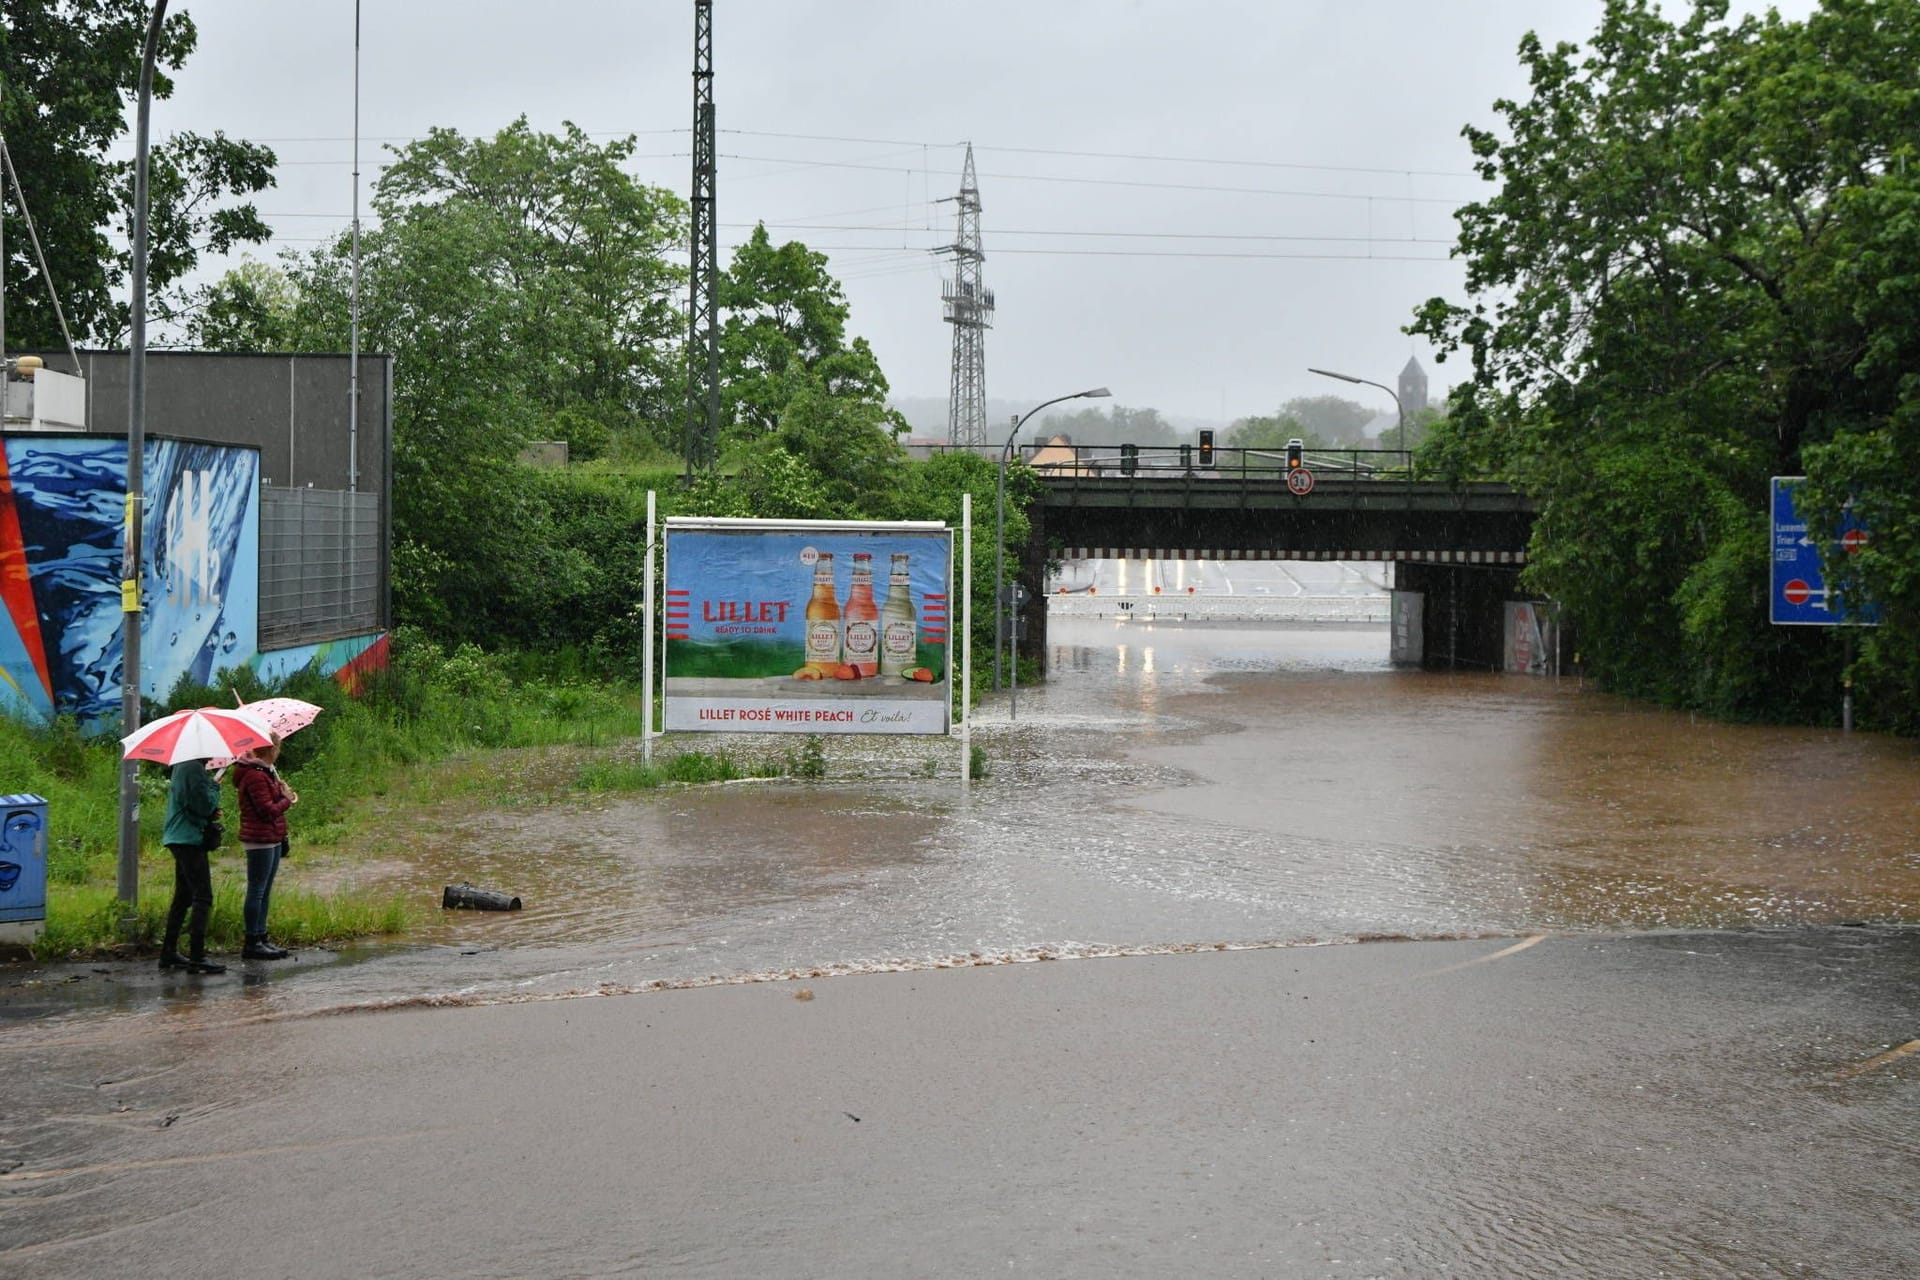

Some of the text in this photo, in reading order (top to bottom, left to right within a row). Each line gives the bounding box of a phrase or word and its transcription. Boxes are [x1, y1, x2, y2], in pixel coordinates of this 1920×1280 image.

[1776, 523, 1807, 532] Luxemb
[704, 601, 789, 622] LILLET
[715, 626, 777, 634] READY TO DRINK
[699, 709, 736, 720] LILLET
[739, 707, 771, 721] ROSÉ
[775, 710, 811, 721] WHITE
[815, 711, 853, 722] PEACH
[860, 709, 879, 723] Et
